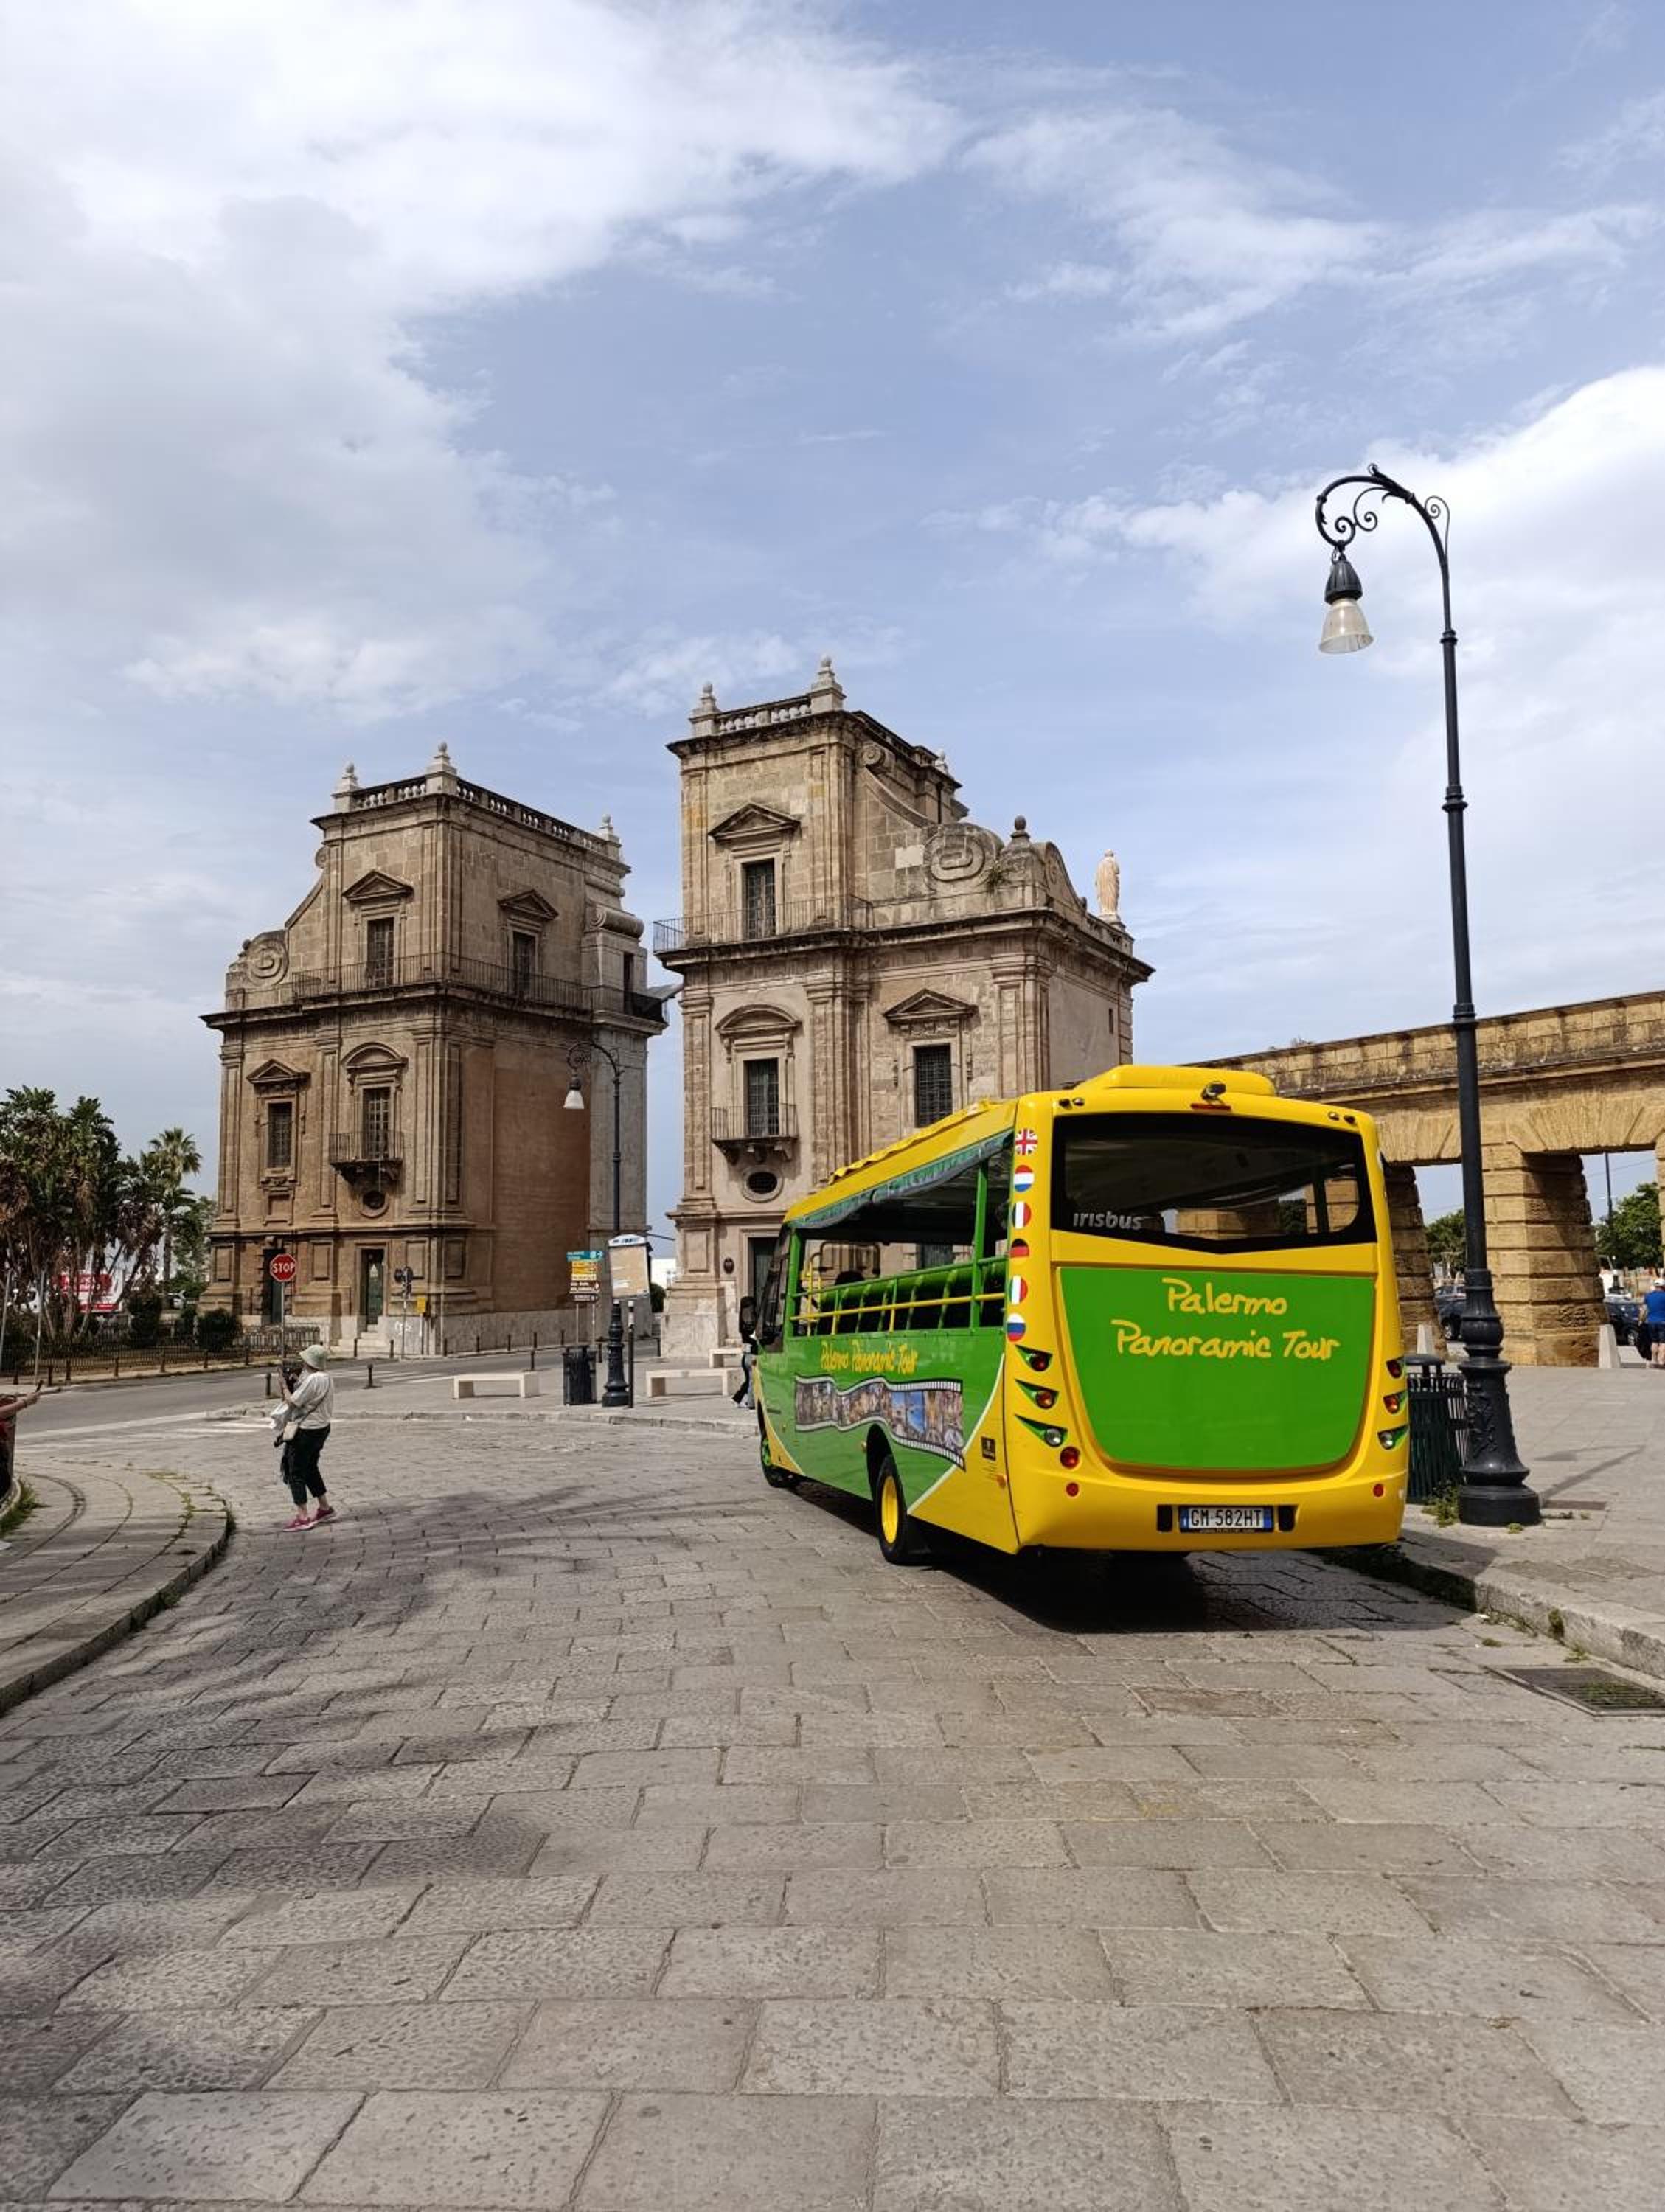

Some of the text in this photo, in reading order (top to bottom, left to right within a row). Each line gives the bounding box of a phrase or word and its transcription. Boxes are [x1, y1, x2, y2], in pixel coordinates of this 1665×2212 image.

[273, 1262, 296, 1273] STOP
[1161, 1277, 1287, 1315] Palermo
[1110, 1319, 1341, 1360] Panoramic Tour
[820, 1340, 849, 1370] Palermo
[897, 1343, 920, 1374] Tour
[1214, 1509, 1264, 1527] 582HT
